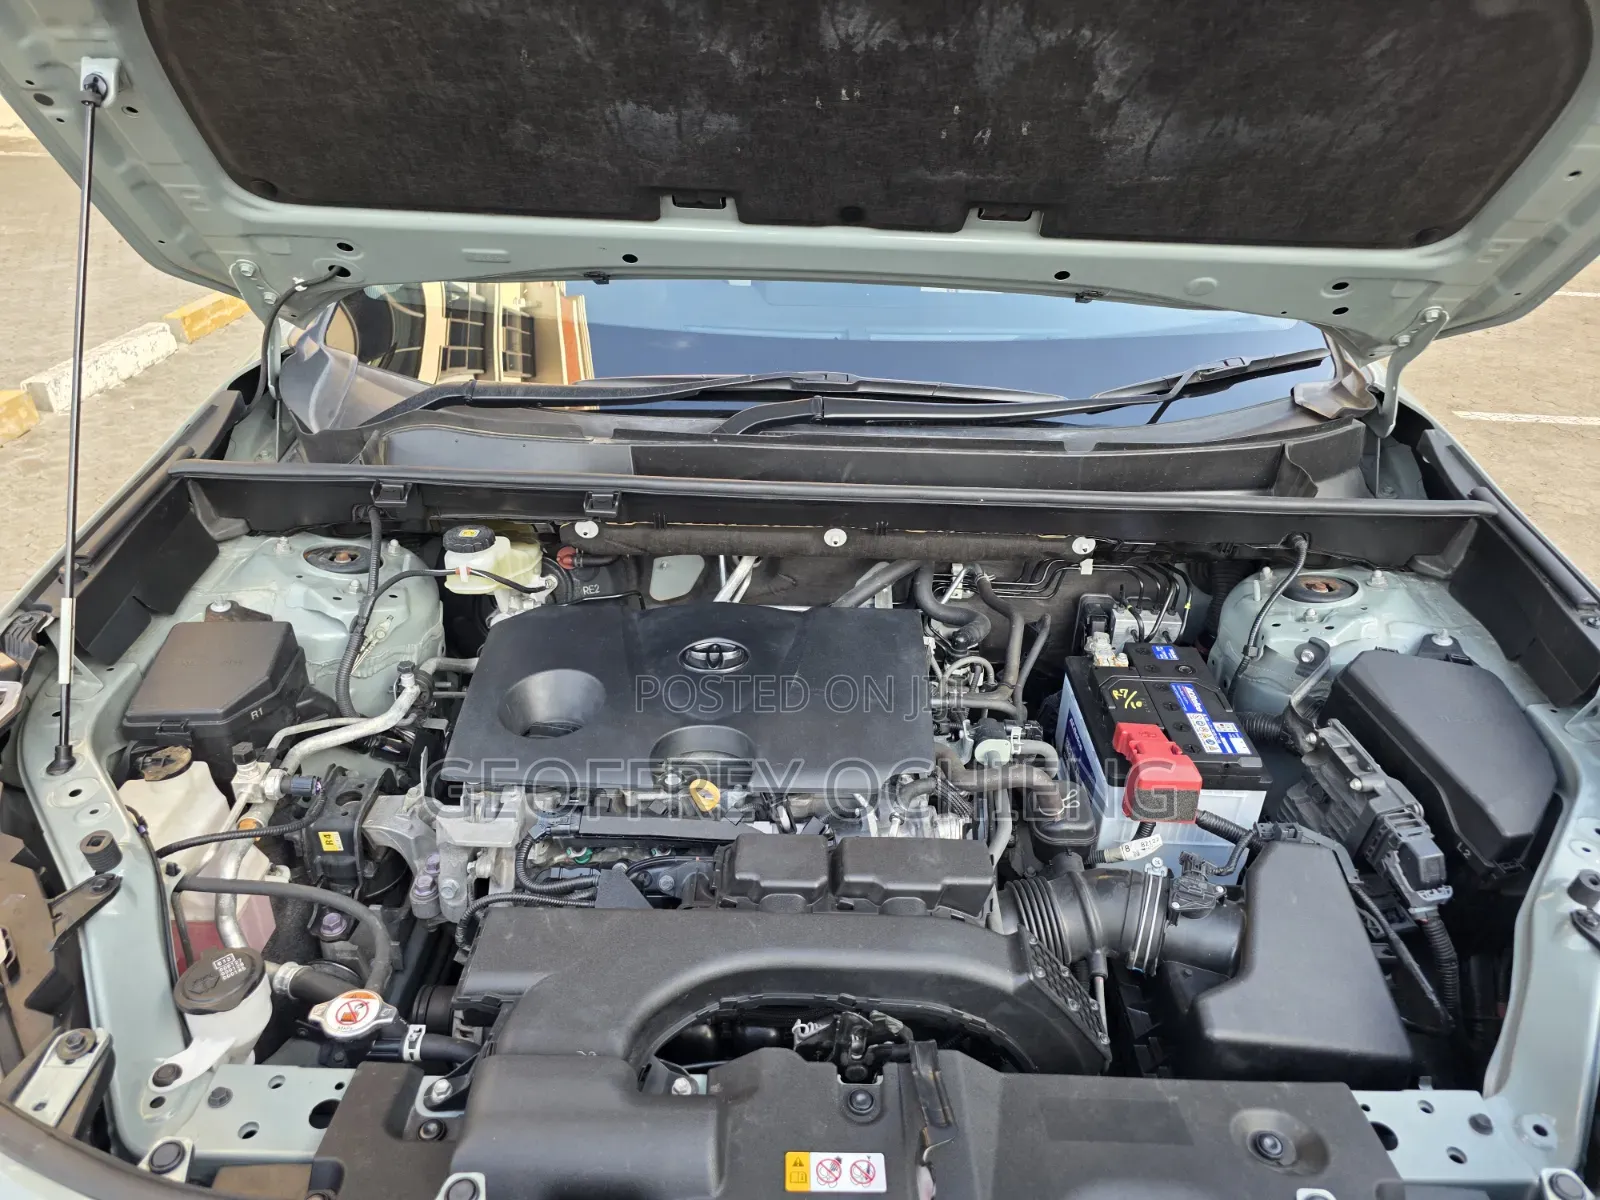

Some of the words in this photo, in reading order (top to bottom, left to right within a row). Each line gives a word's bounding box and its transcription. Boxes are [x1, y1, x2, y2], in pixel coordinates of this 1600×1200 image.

[582, 583, 601, 596] RE2
[250, 707, 263, 720] R1
[323, 834, 334, 846] R4
[1456, 841, 1472, 859] L2
